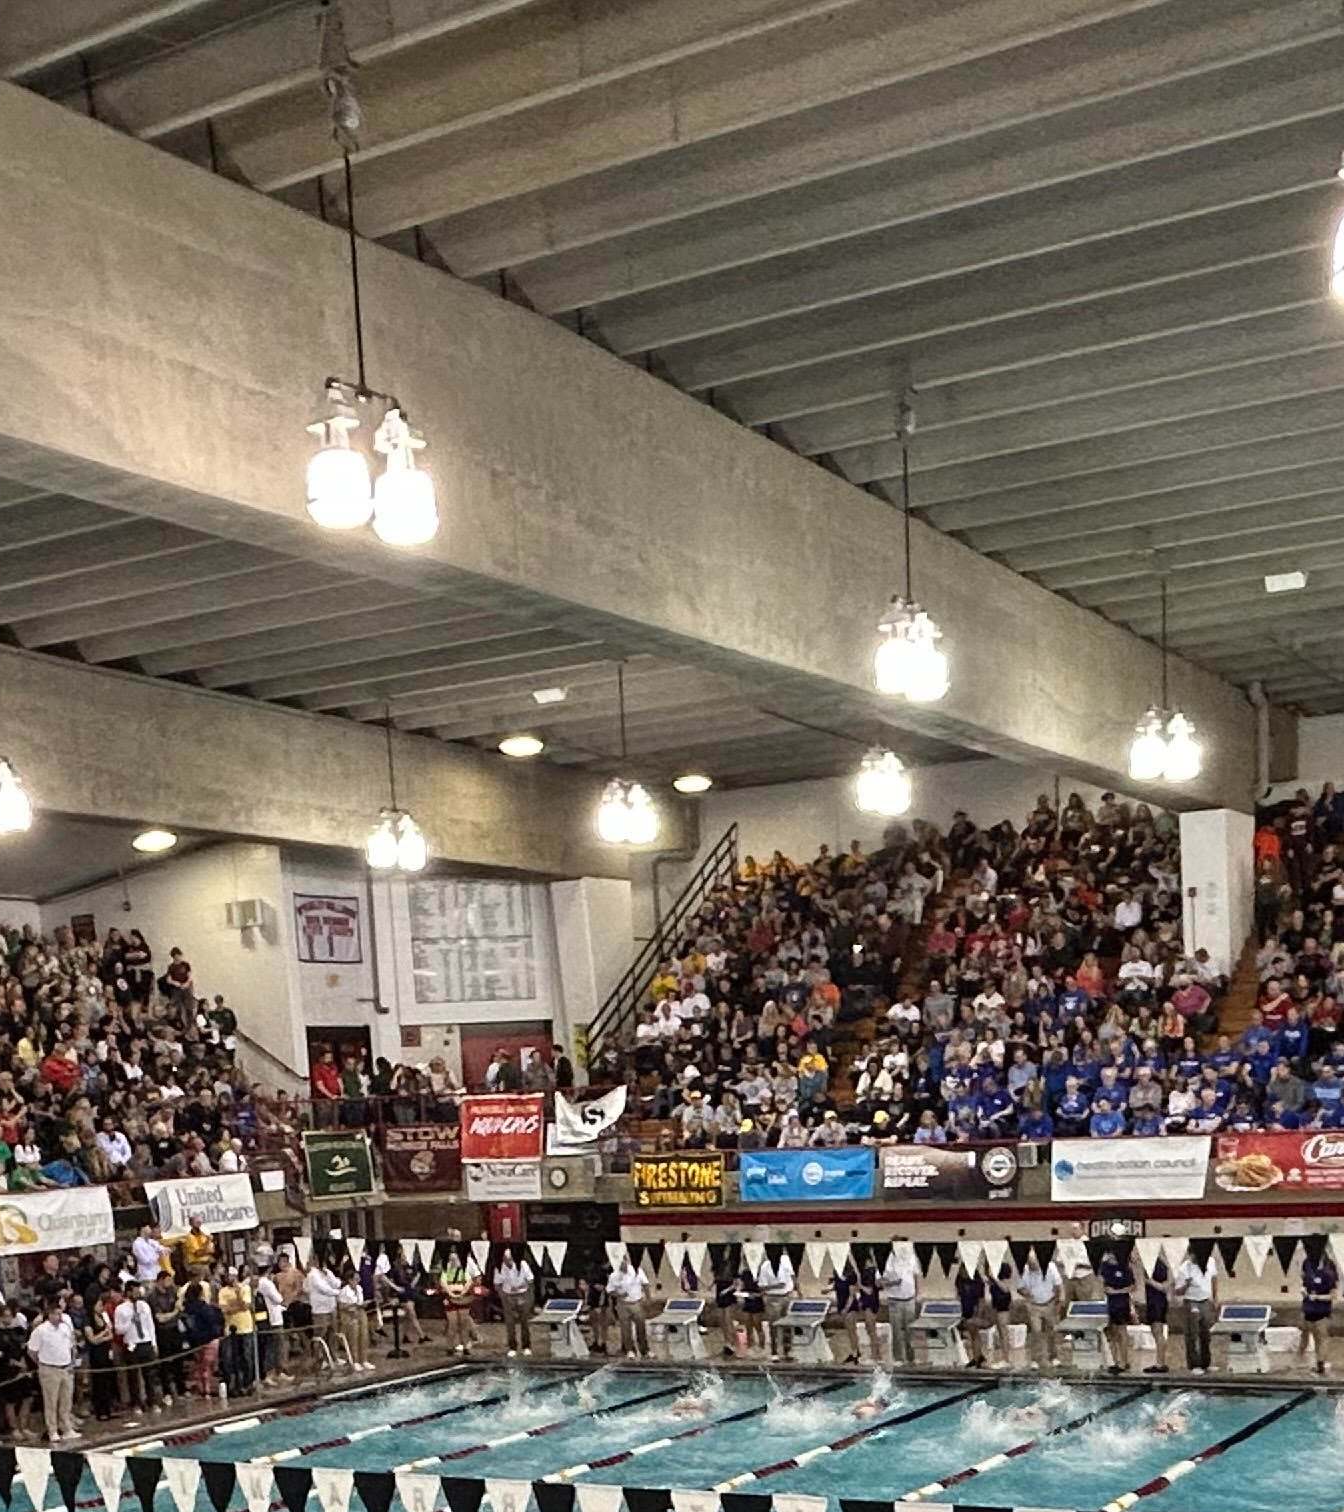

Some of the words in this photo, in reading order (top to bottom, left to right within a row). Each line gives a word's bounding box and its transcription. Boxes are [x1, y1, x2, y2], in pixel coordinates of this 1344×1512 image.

[386, 1125, 459, 1141] STOW
[634, 1160, 722, 1189] FIRESTONE
[177, 1184, 223, 1206] United
[181, 1203, 255, 1227] Healthcare
